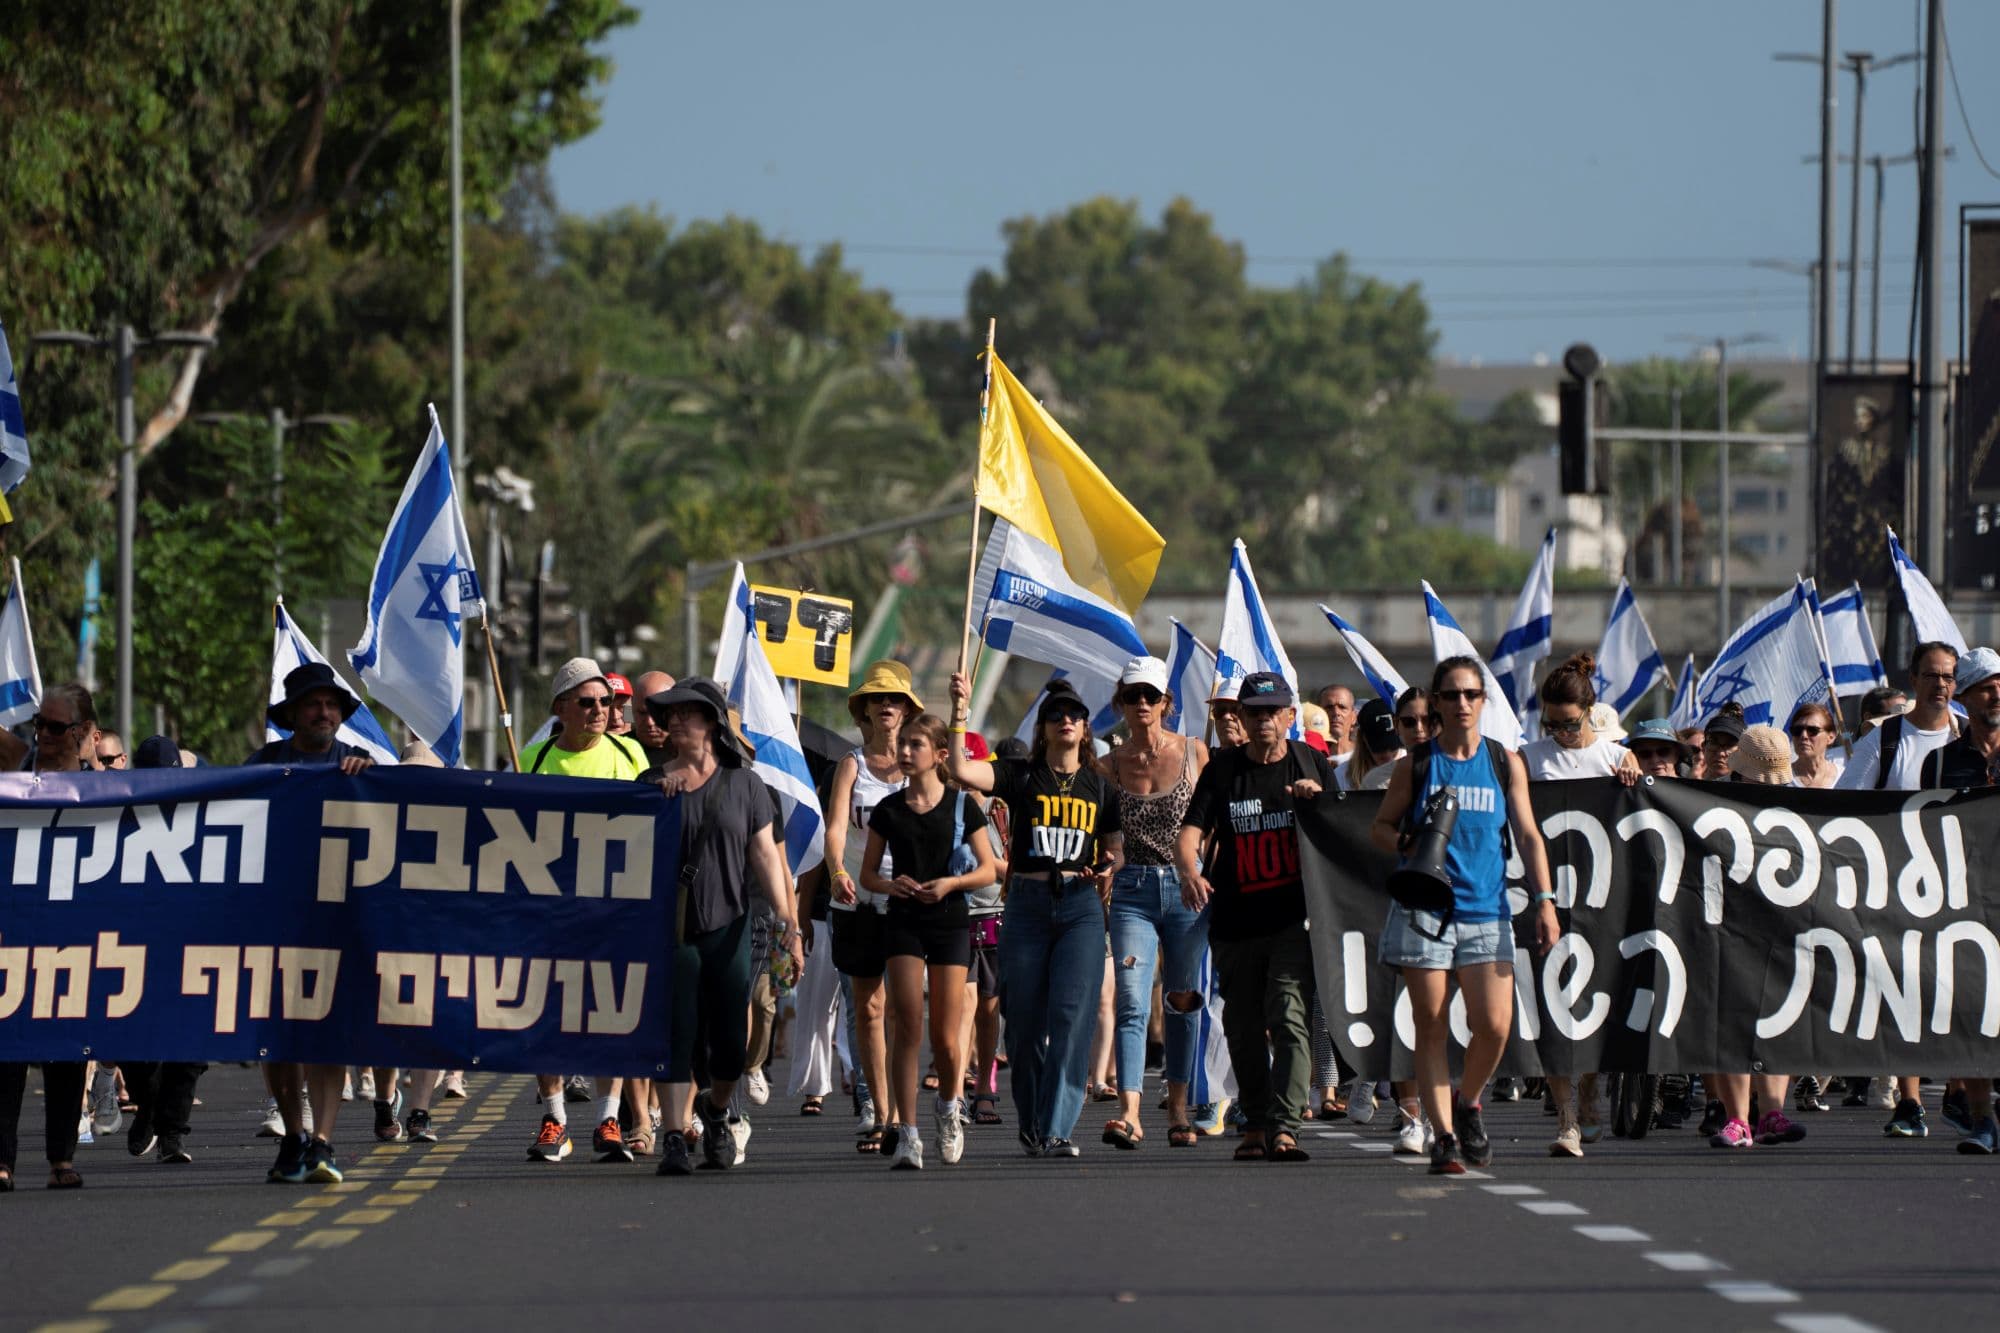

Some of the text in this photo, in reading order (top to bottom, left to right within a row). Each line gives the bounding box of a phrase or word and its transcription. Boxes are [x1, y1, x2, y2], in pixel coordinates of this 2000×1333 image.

[317, 800, 656, 902] מאבק
[1229, 799, 1262, 818] BRING
[1230, 810, 1294, 834] THEM HOME
[181, 945, 342, 1033] סוף
[376, 952, 649, 1035] עושים
[1755, 920, 2000, 1043] חמת
